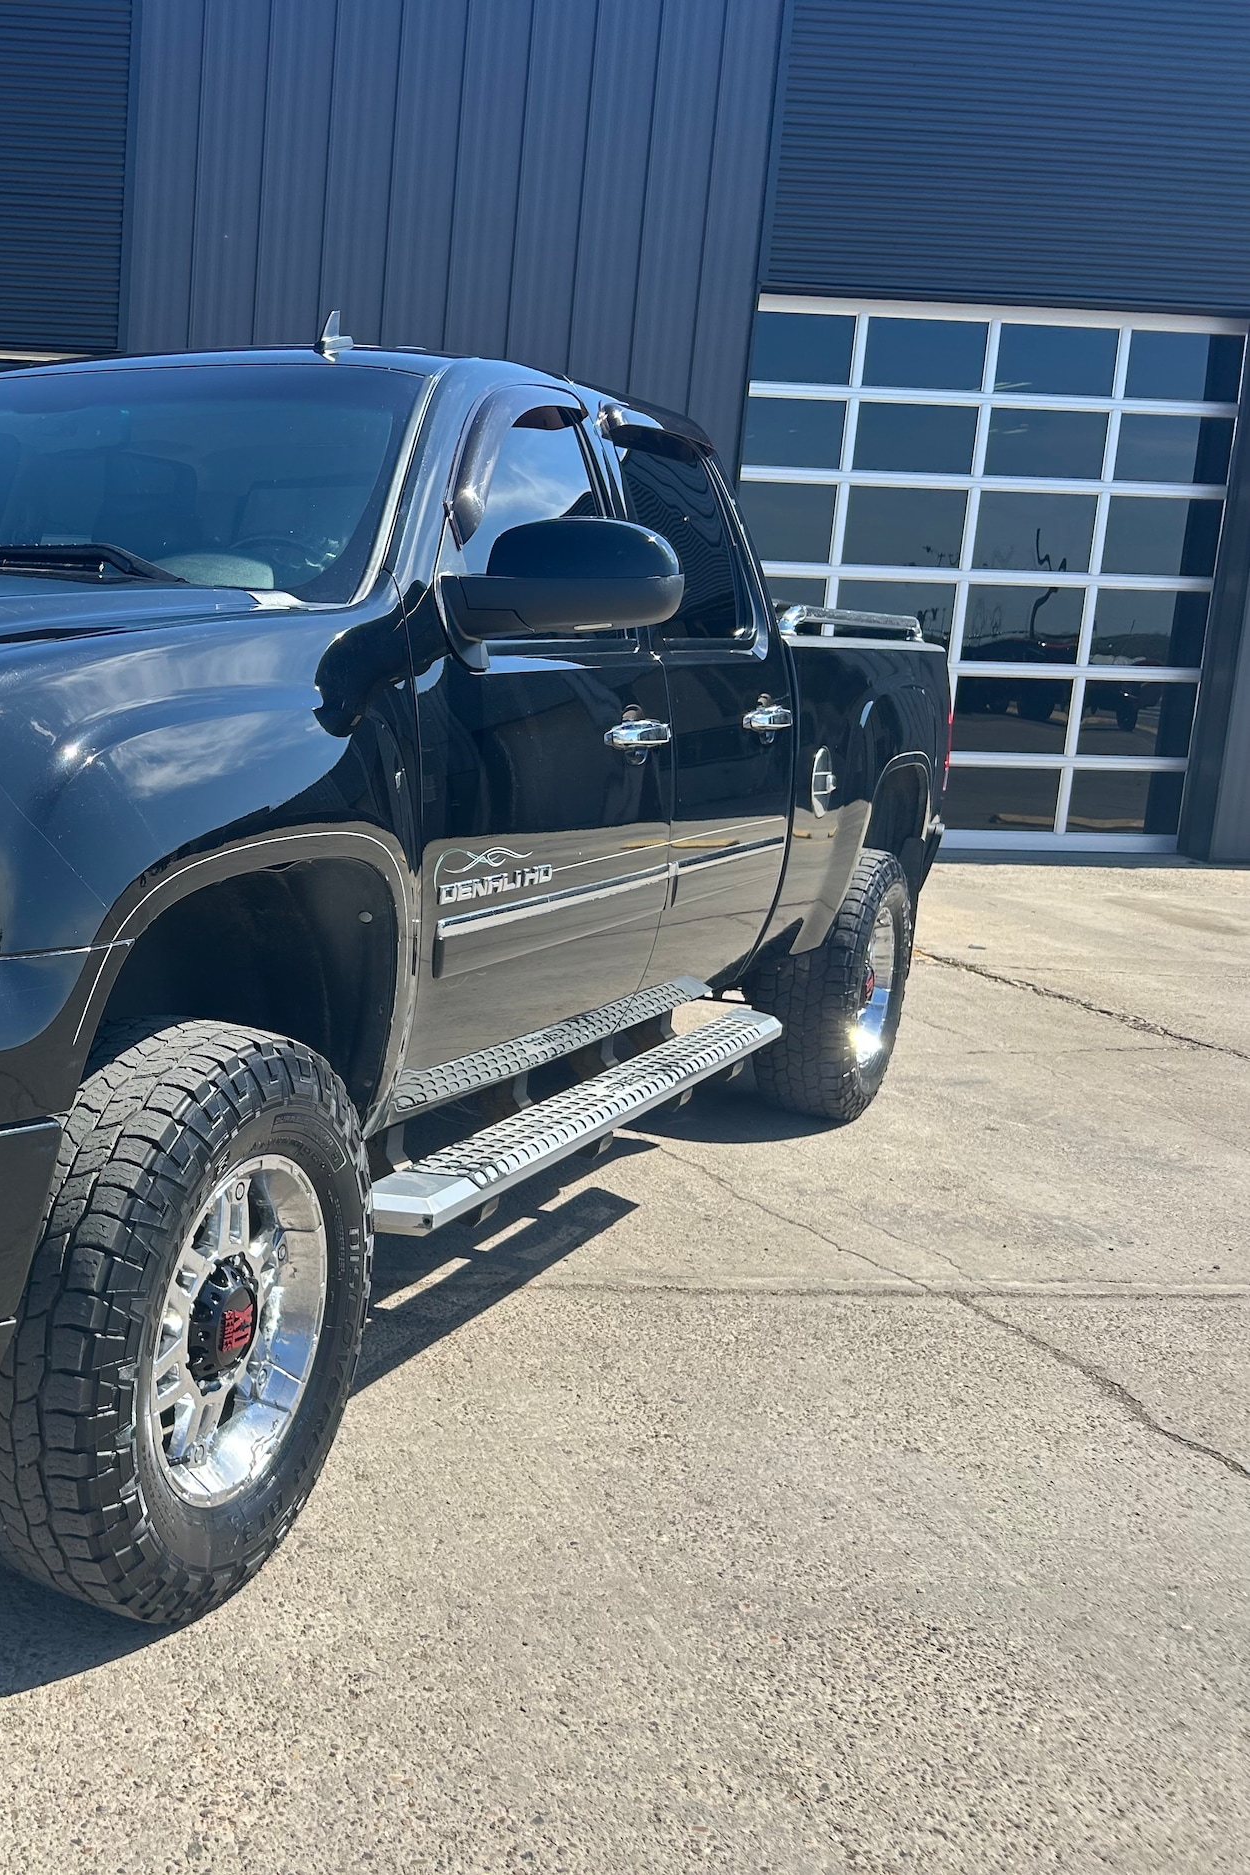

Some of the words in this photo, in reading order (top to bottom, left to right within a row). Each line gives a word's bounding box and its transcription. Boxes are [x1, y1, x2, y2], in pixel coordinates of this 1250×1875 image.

[437, 869, 522, 905] DENALI
[523, 864, 552, 886] HD
[222, 1310, 235, 1353] SERIES
[232, 1303, 254, 1350] XD
